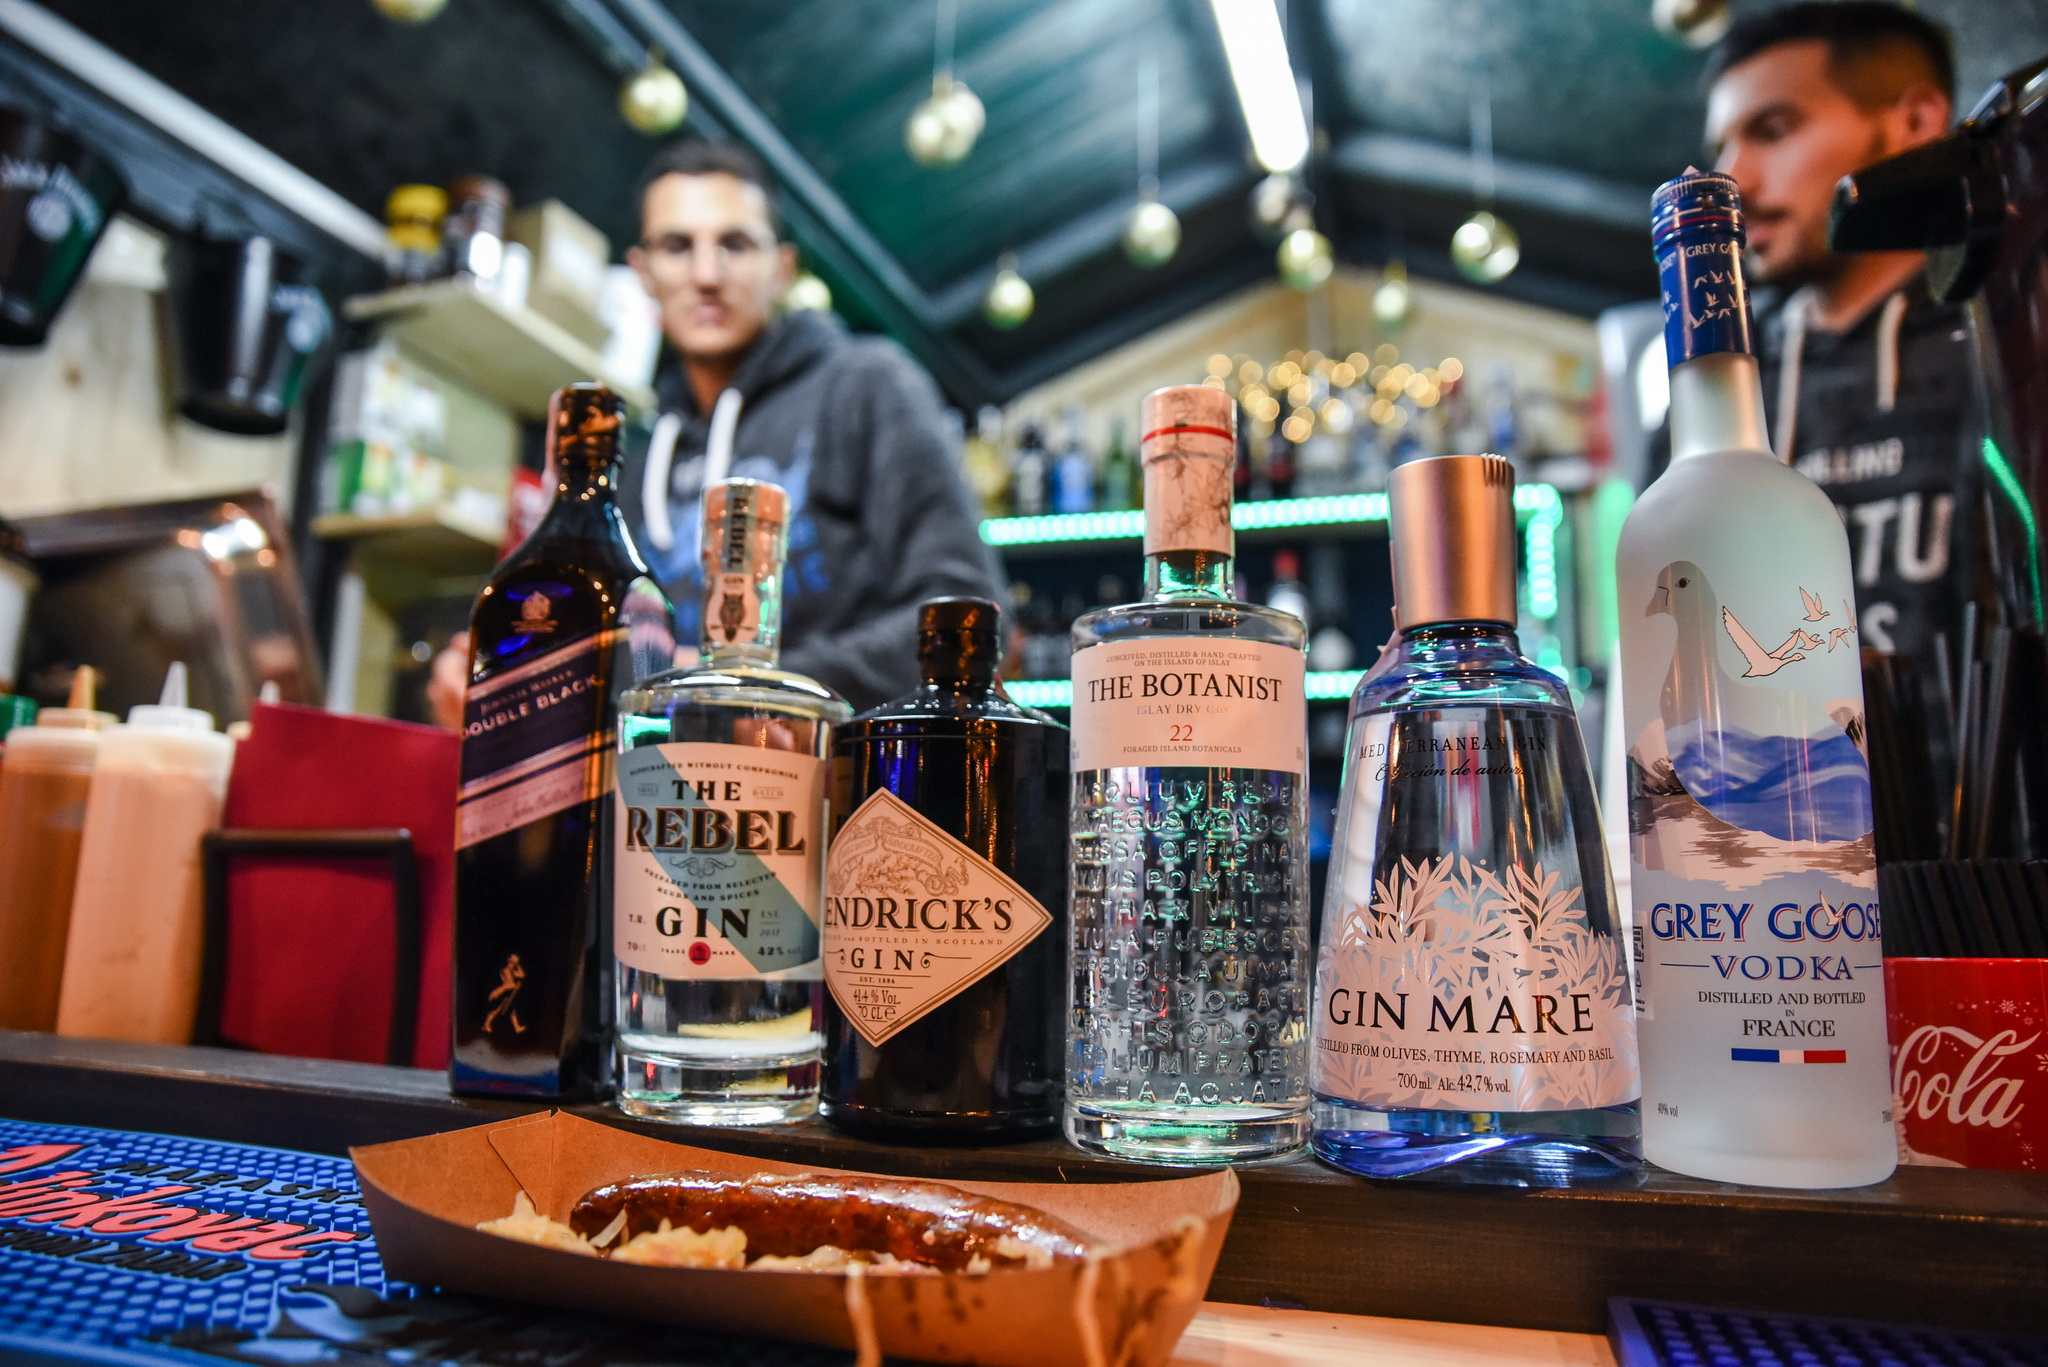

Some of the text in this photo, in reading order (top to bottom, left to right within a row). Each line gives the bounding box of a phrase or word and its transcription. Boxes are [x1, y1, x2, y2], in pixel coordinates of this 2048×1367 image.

[1686, 243, 1717, 257] GREY
[1840, 491, 1955, 588] TU
[1106, 651, 1147, 663] CONCEIVED,
[1150, 650, 1191, 659] DISTILLED
[1200, 651, 1261, 662] HAND-CRAFTED
[1208, 659, 1230, 667] ISLAY
[1088, 673, 1282, 703] THE BOTANIST
[1136, 704, 1171, 715] ISLAY
[1176, 704, 1201, 714] DRY
[1169, 724, 1193, 742] 22
[1123, 745, 1158, 753] FORAGED
[1192, 745, 1242, 753] BOTANICALS
[1516, 736, 1547, 751] GIN
[687, 761, 732, 770] WITHOUT
[737, 764, 799, 780] COMPROMISE
[1450, 759, 1471, 777] de
[672, 780, 742, 801] THE
[752, 788, 784, 798] BATCH
[626, 806, 807, 855] REBEL
[693, 882, 721, 890] FROM
[726, 871, 777, 888] SELECTED
[693, 894, 715, 902] AND
[720, 889, 760, 901] SPICES
[656, 906, 750, 938] GIN
[825, 896, 1014, 932] ENDRICK'S
[1651, 902, 1882, 943] GREY GOOSE
[936, 938, 1003, 946] SCOTLAND
[850, 947, 914, 971] GIN
[1711, 955, 1854, 981] VODKA
[1698, 991, 1866, 1005] DISTILLED AND BOTTLED
[1329, 988, 1595, 1036] GIN MARE
[1785, 1009, 1795, 1017] IN
[1742, 1018, 1836, 1038] FRANCE
[1351, 1043, 1380, 1058] FROM
[1383, 1046, 1431, 1062] OLIVES,
[1434, 1049, 1486, 1064] THYME,
[1490, 1051, 1560, 1064] ROSEMARY
[1562, 1049, 1586, 1062] AND
[1893, 1024, 2042, 1129] Cola
[1657, 1102, 1679, 1118] 40% vol
